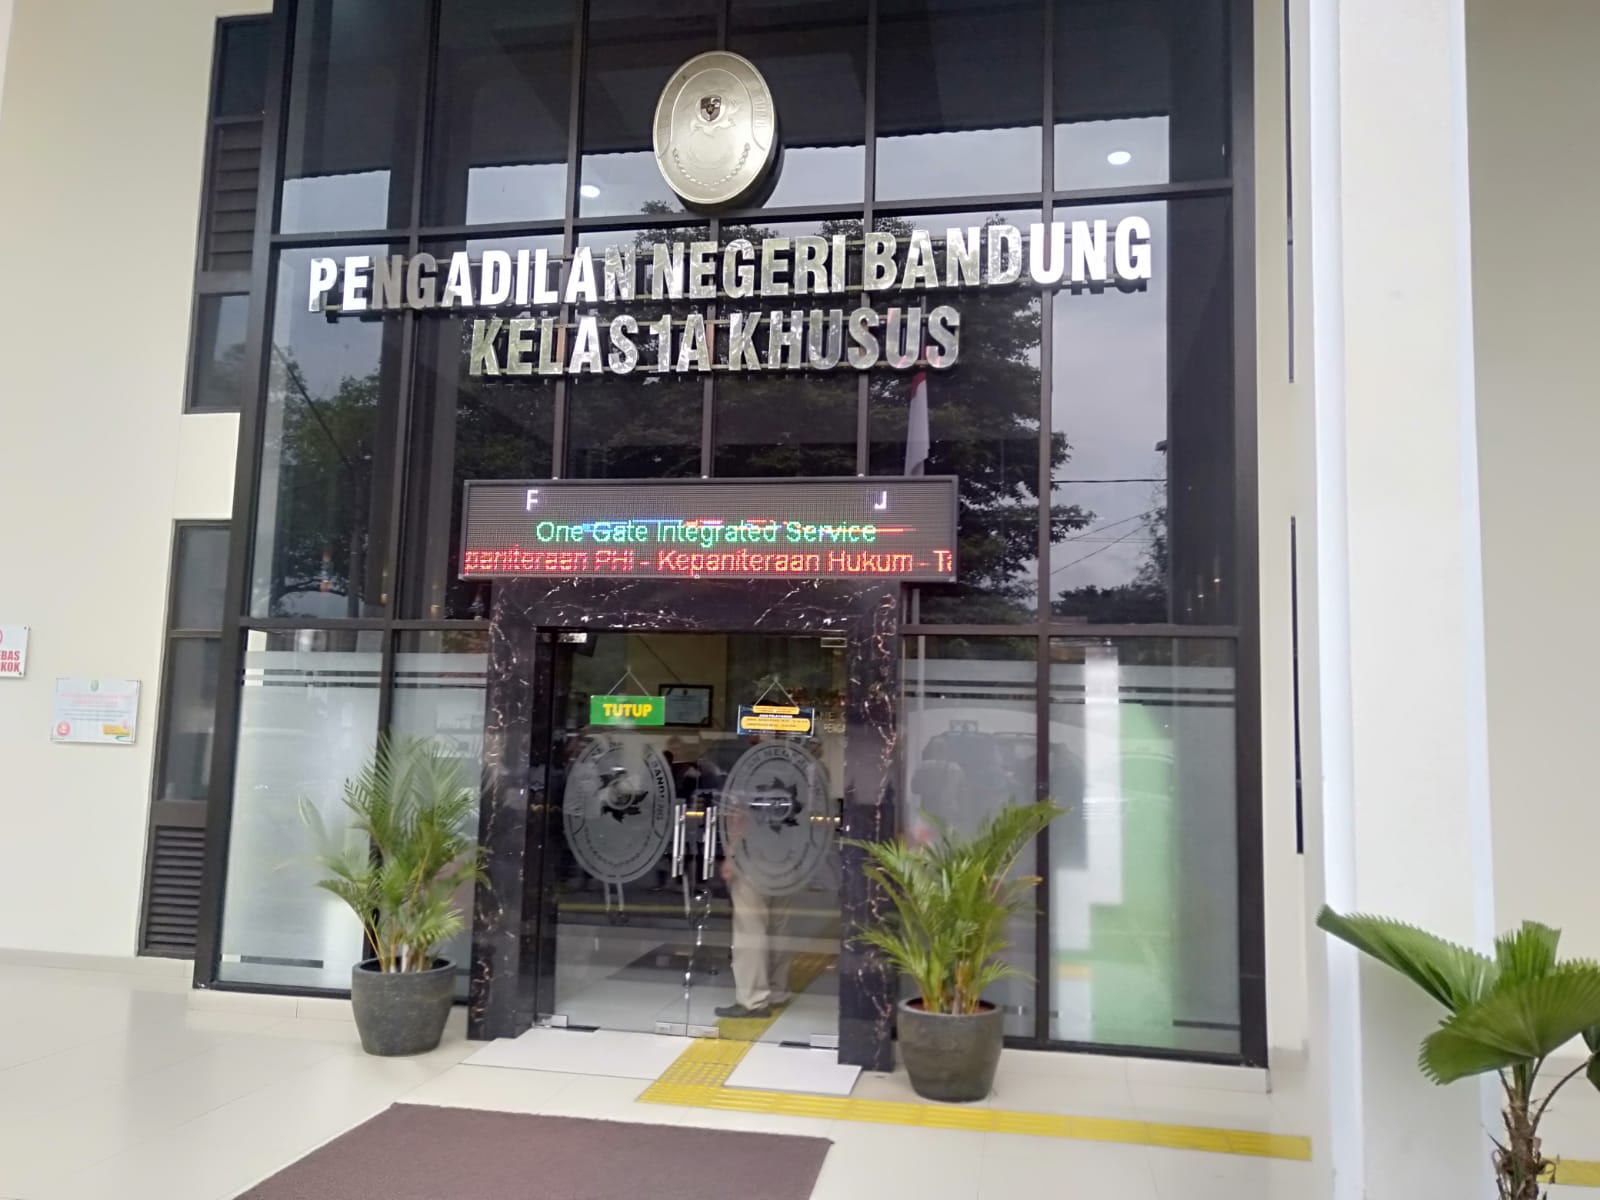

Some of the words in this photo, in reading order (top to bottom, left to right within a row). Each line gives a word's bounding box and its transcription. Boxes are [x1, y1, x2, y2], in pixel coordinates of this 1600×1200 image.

[308, 243, 636, 312] PENGADILAN
[652, 234, 846, 300] NEGERI
[864, 216, 1152, 291] BANDUNG
[469, 314, 639, 375] KELAS
[650, 313, 711, 372] 1A
[727, 305, 961, 371] KHUSUS
[525, 489, 539, 511] F
[873, 490, 888, 510] J
[535, 521, 584, 543] One
[592, 519, 648, 543] Gate
[657, 519, 776, 548] Integrated
[786, 519, 876, 543] Service
[657, 549, 819, 577] Kepaniteraan
[828, 549, 913, 573] Hukum
[0, 650, 20, 660] BAS
[0, 662, 20, 672] KOK
[602, 703, 653, 718] TUTUP
